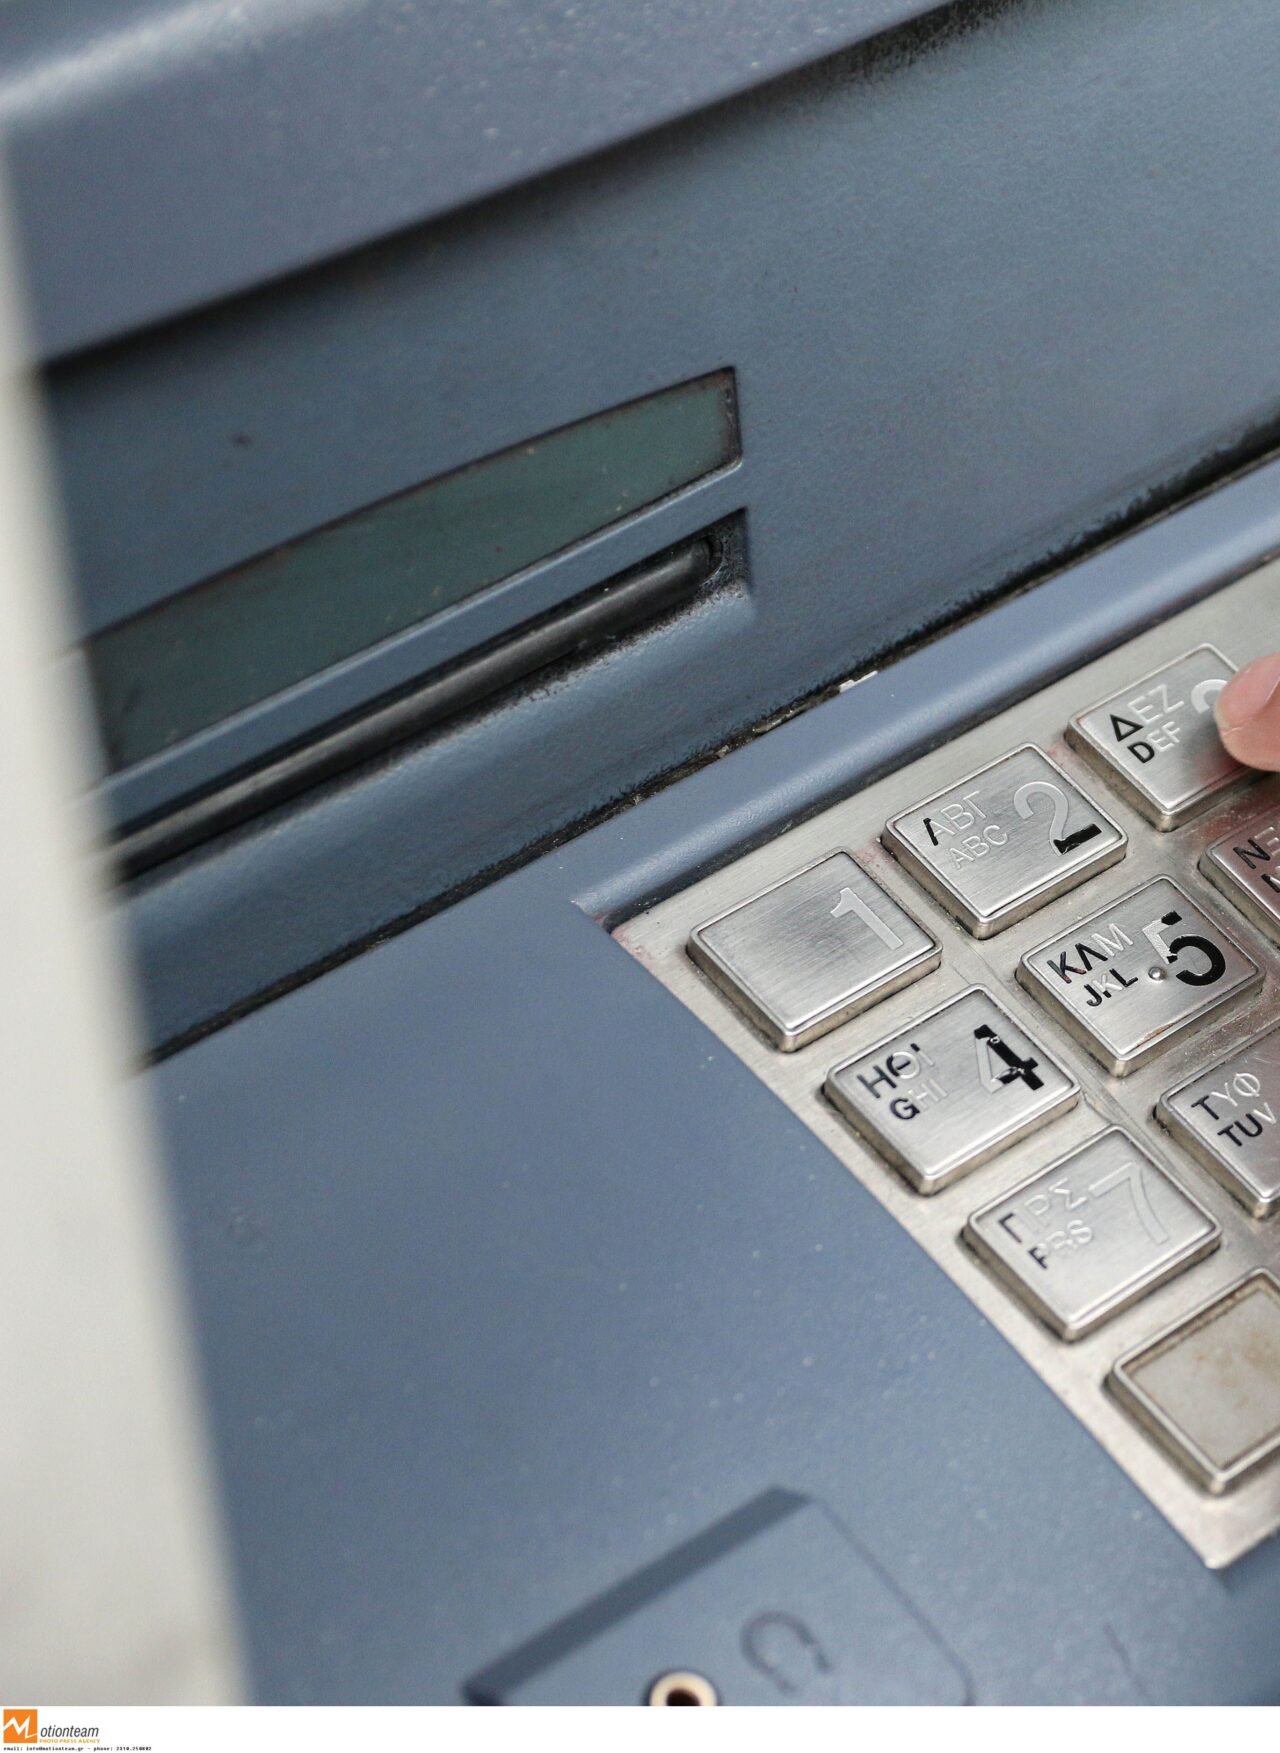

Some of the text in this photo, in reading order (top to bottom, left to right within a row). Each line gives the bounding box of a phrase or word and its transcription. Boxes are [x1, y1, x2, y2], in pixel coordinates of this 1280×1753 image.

[1127, 721, 1181, 764] DEF
[950, 825, 1009, 869] ABC
[1013, 781, 1102, 857] 2
[830, 887, 904, 950] 1
[1142, 911, 1226, 987] 5
[1084, 968, 1139, 1007] JKL
[973, 1024, 1045, 1093] 4
[1217, 1102, 1277, 1147] TUV
[1088, 1162, 1170, 1245] 7
